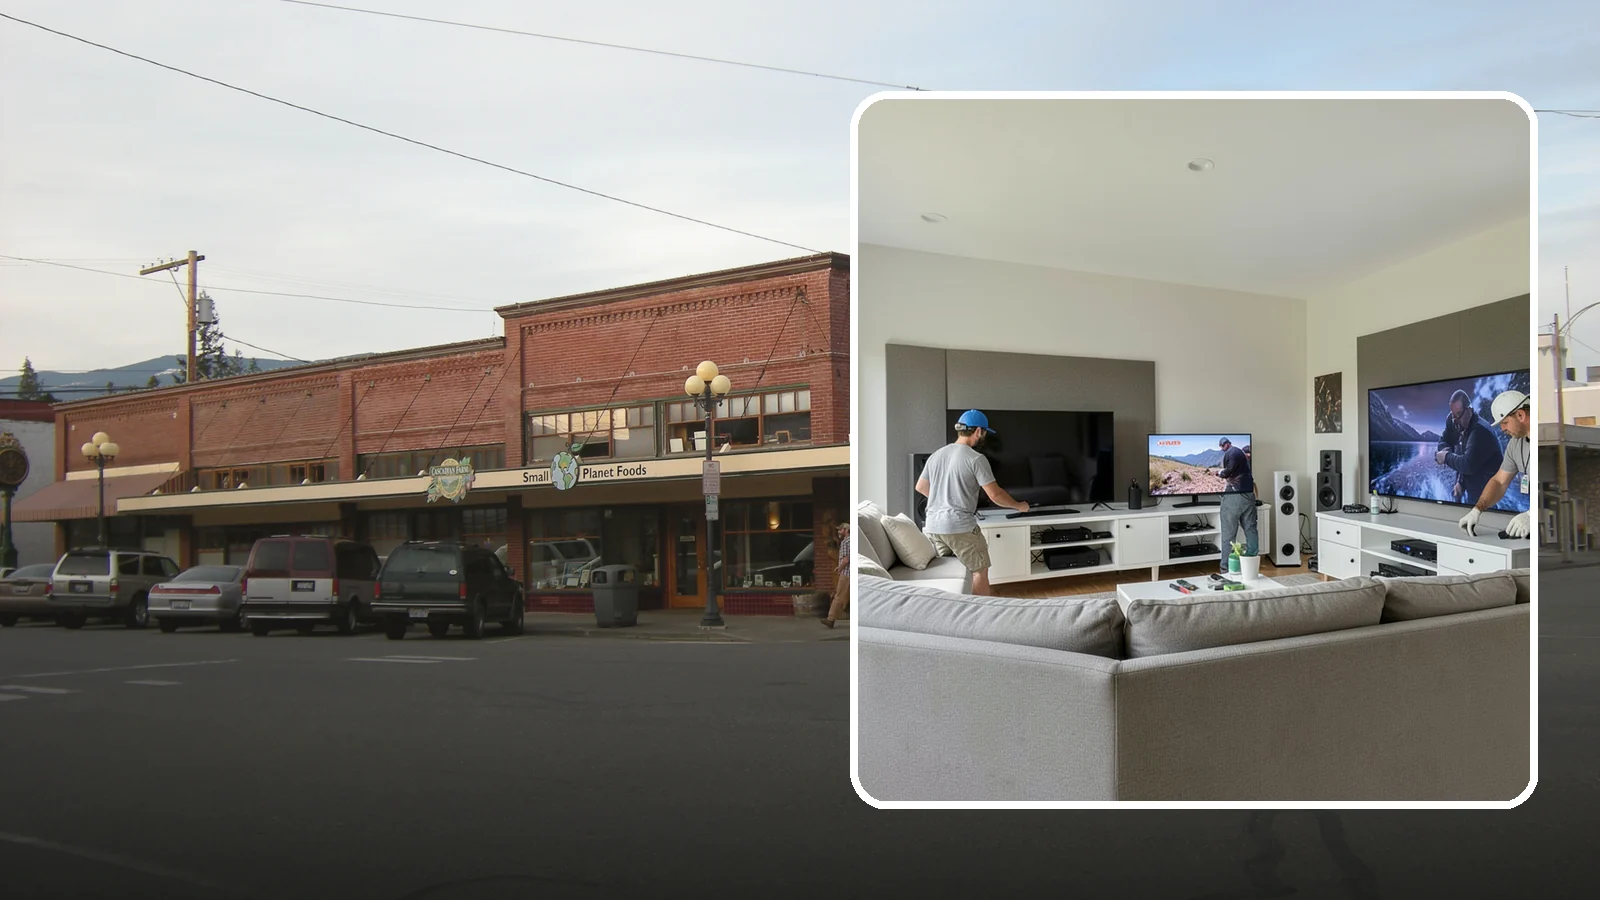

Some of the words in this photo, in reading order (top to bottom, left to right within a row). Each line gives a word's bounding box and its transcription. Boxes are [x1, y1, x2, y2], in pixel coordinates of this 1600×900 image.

[523, 471, 549, 483] Small
[582, 467, 614, 479] Planet
[616, 464, 647, 477] Foods
